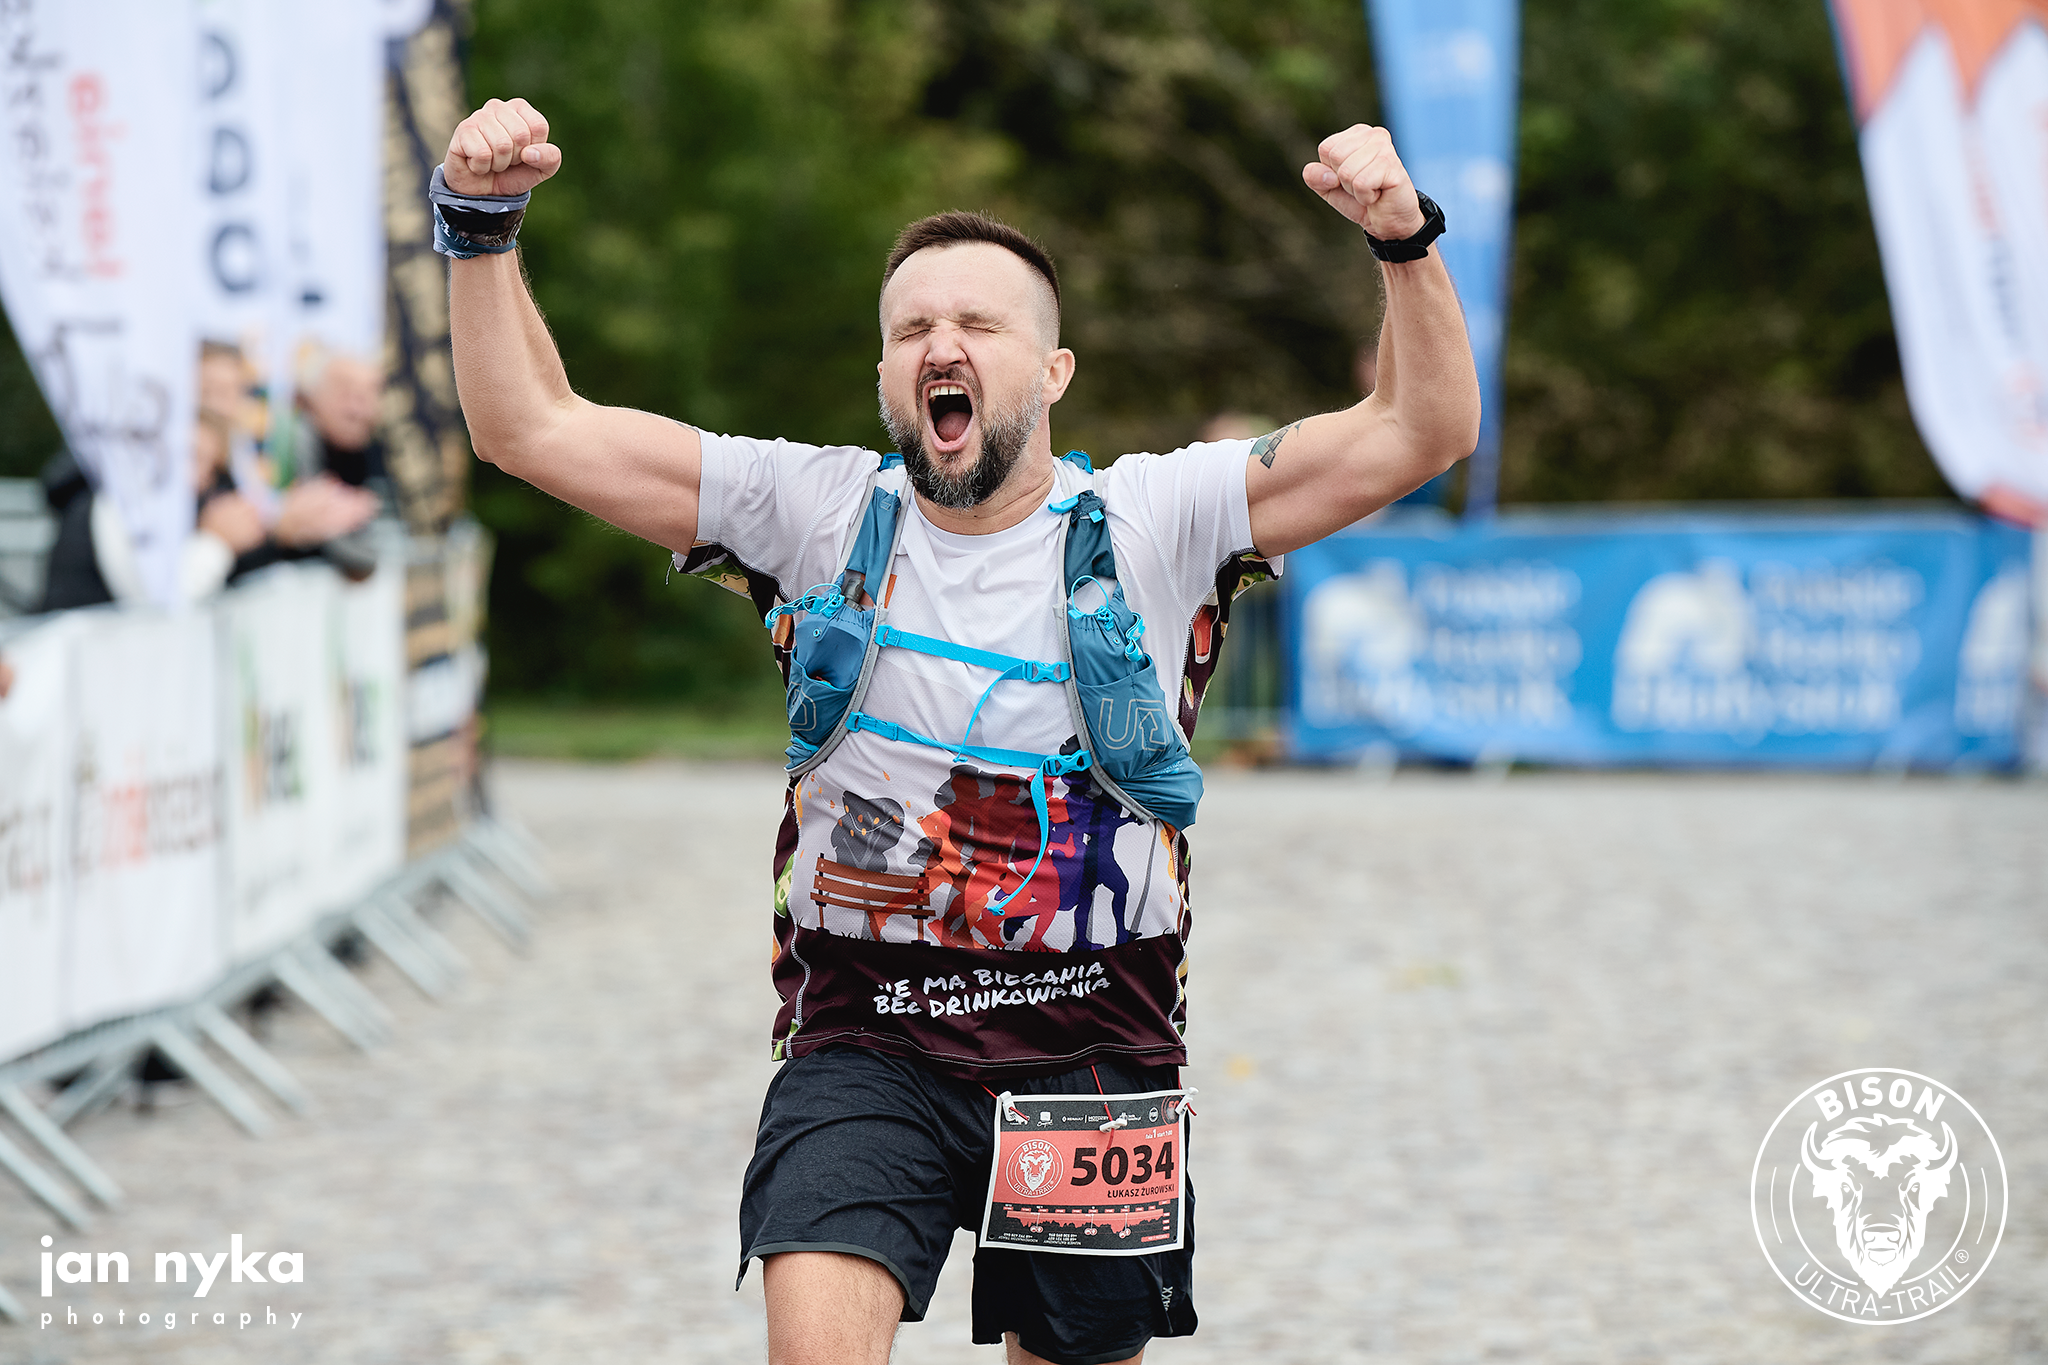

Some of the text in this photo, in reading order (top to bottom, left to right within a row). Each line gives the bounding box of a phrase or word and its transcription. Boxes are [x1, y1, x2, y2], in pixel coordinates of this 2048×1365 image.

[923, 974, 966, 995] MA
[1022, 1141, 1051, 1152] BISON
[1070, 1141, 1174, 1187] 5034
[1107, 1183, 1175, 1199] ŁUKASZ ŻUROWSKI
